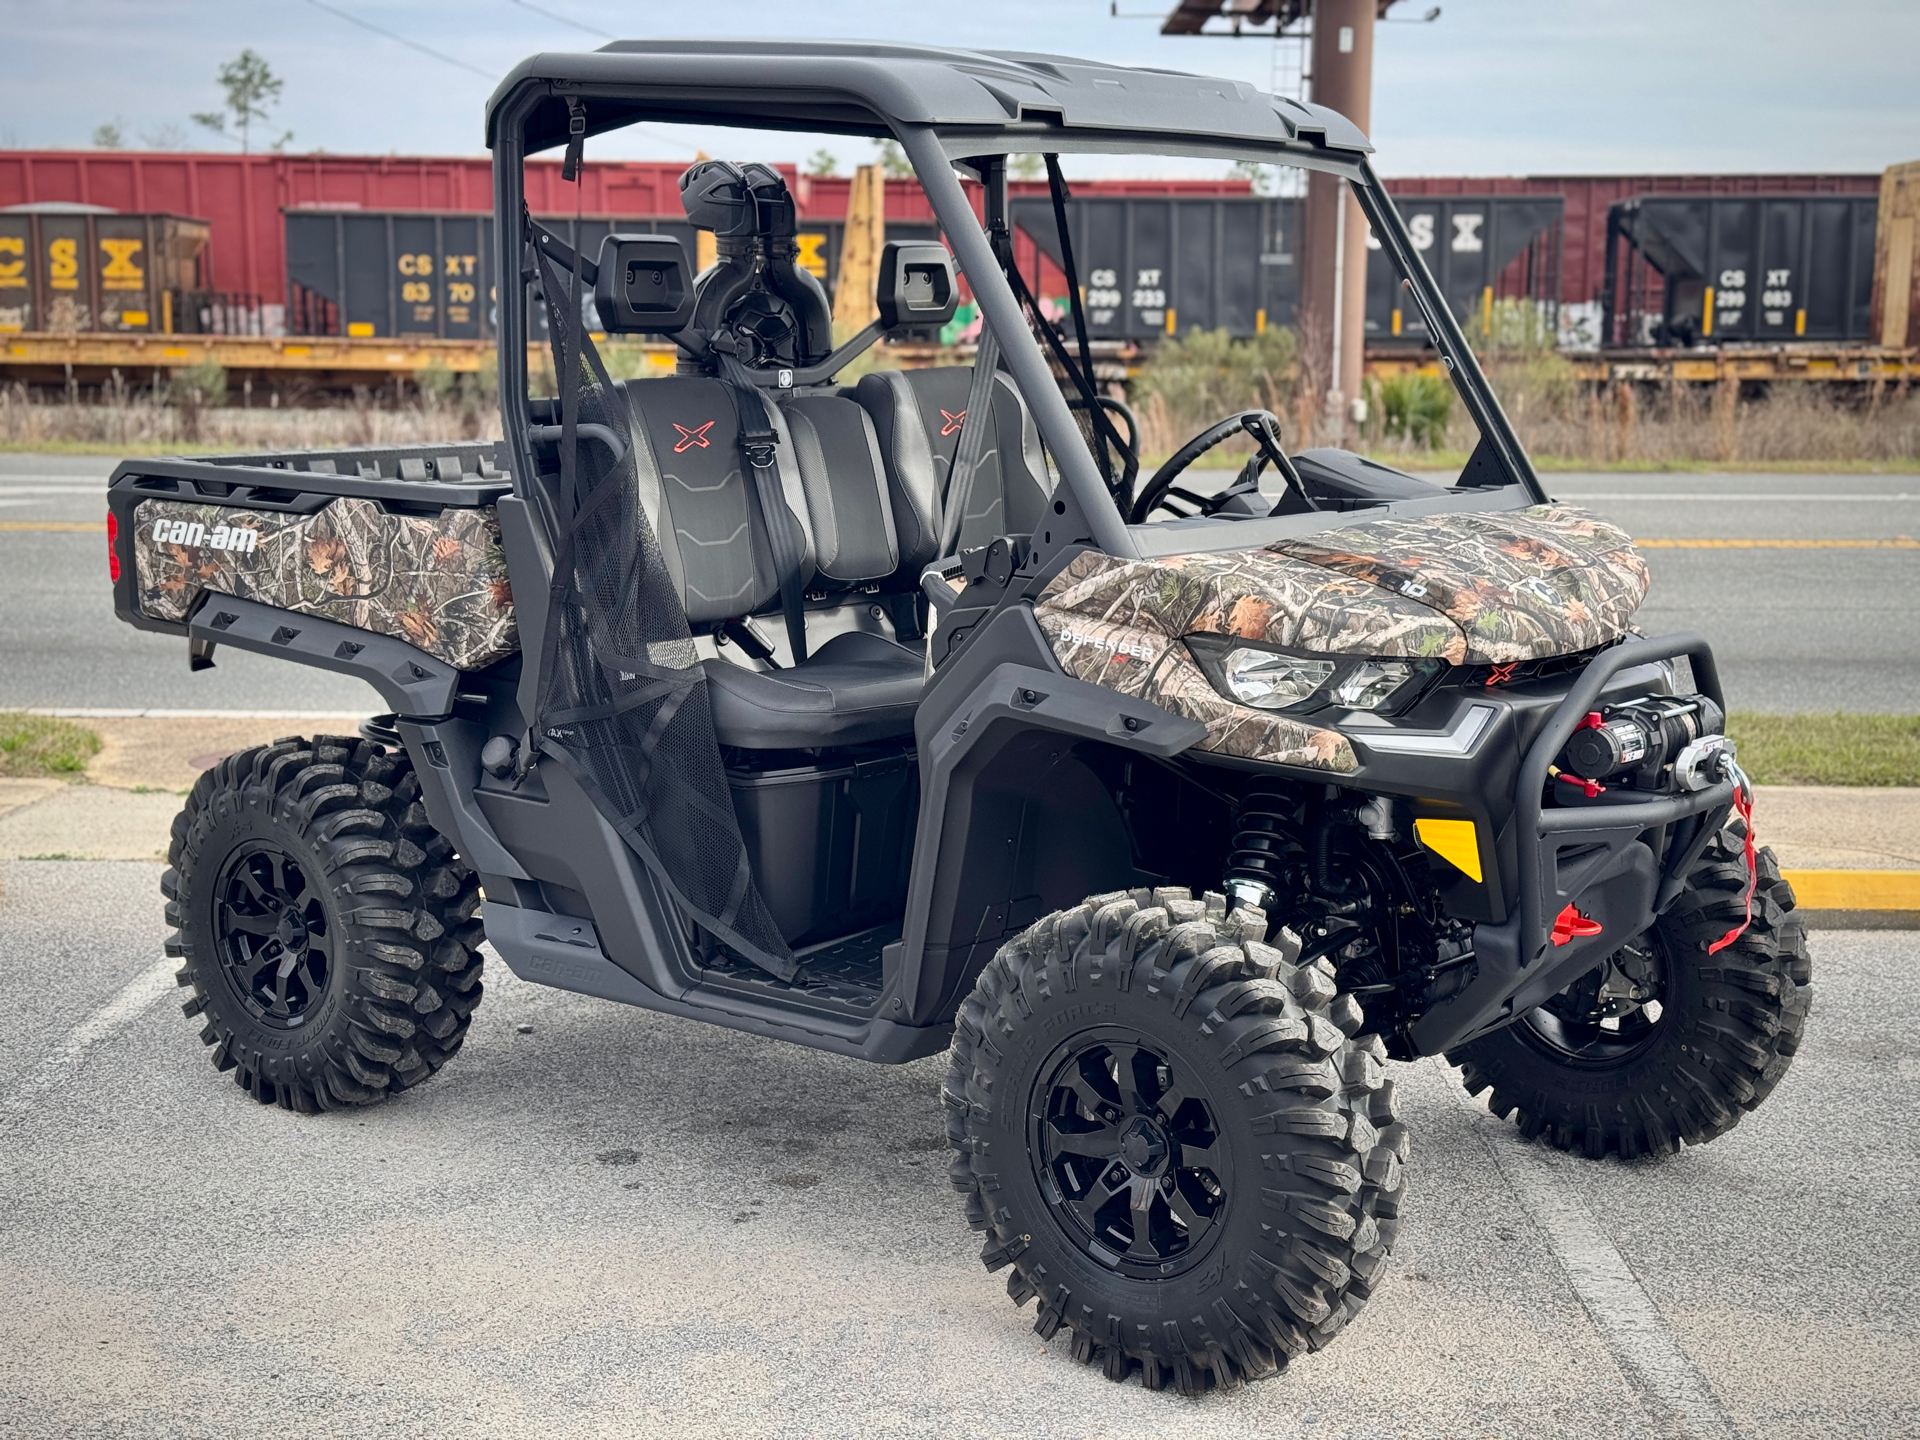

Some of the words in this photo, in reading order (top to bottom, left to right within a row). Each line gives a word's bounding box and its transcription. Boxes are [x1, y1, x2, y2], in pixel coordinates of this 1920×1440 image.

[398, 254, 433, 276] CS
[445, 255, 477, 276] XT
[1091, 269, 1116, 288] CS
[1138, 269, 1161, 287] XT
[1720, 269, 1746, 288] CS
[1766, 269, 1791, 287] XT
[448, 283, 475, 303] 70
[152, 518, 258, 553] can-am
[1060, 629, 1154, 660] DEFENDER
